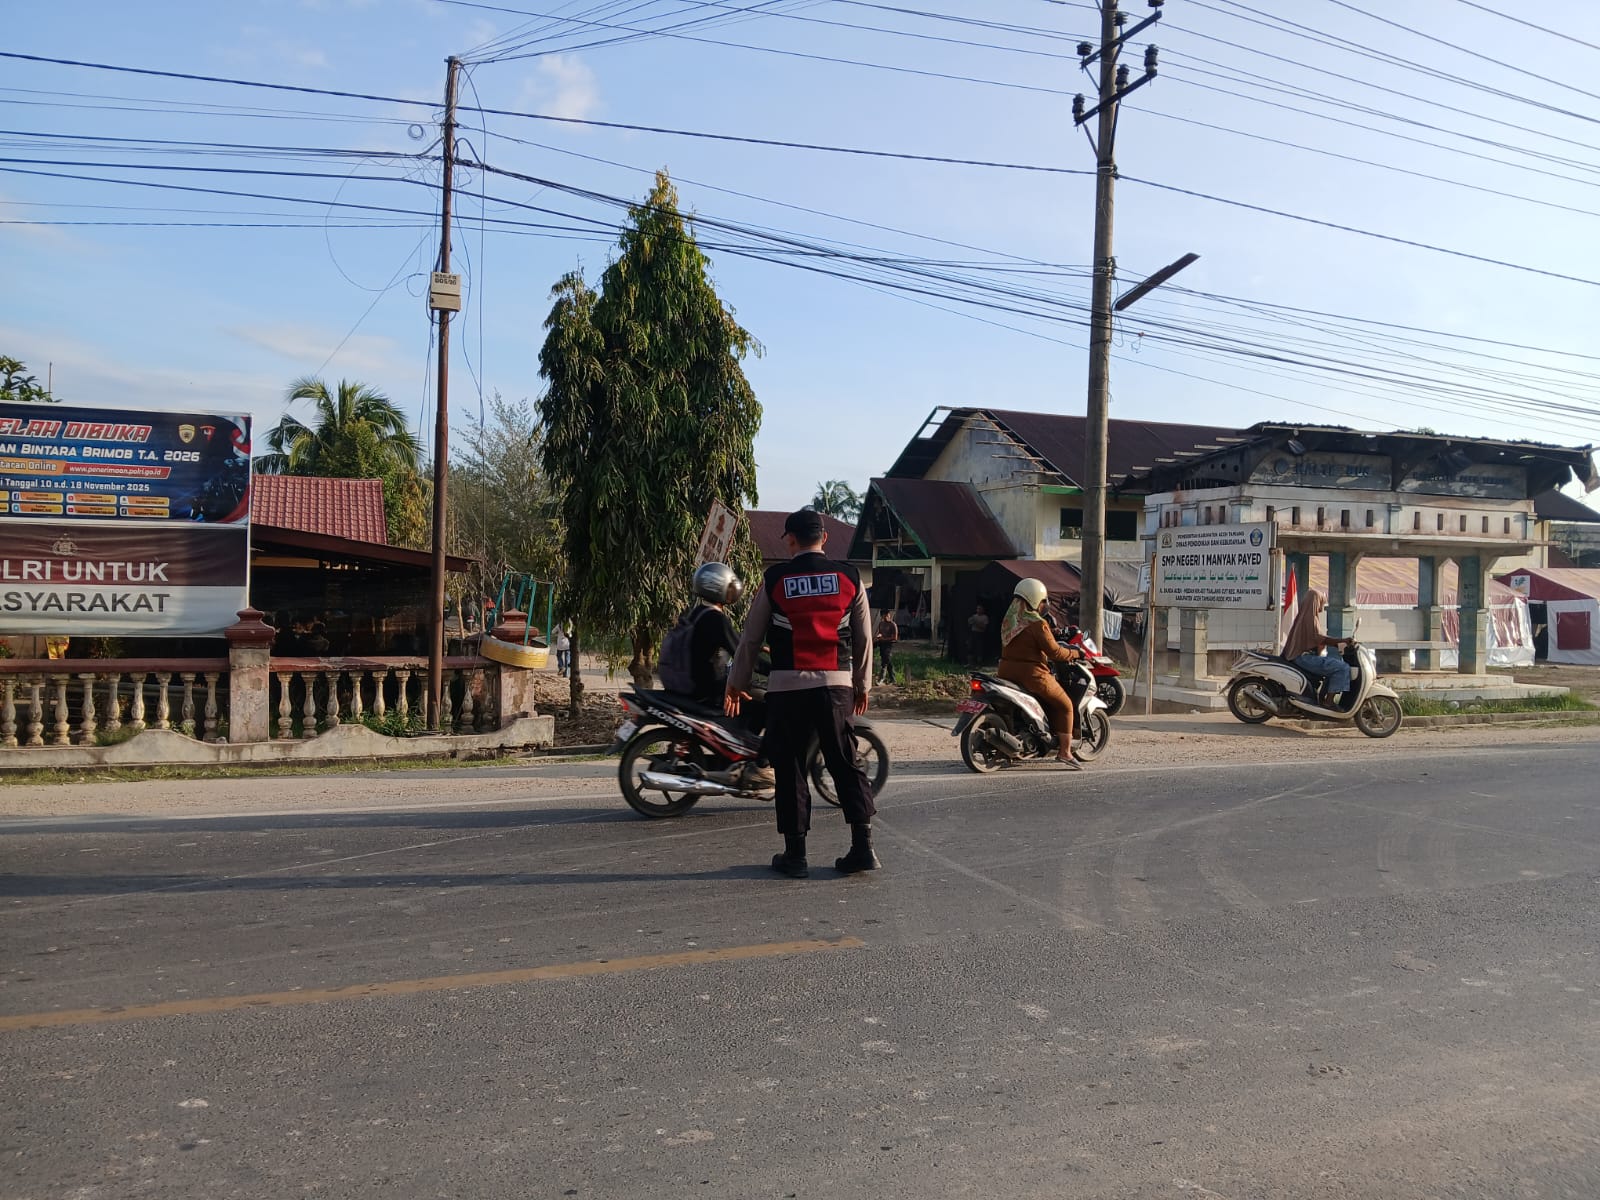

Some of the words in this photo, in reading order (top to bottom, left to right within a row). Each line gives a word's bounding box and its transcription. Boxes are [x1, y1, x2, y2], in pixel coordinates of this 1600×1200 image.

[62, 421, 152, 443] DIBUKA
[21, 443, 77, 457] BINTARA
[82, 446, 133, 459] BRIMOB
[138, 449, 159, 460] T.A.
[164, 450, 200, 462] 2026
[28, 460, 57, 471] Online
[69, 465, 162, 476] www.penerimaan.polri.go.id
[5, 478, 38, 489] Tanggal
[40, 480, 52, 488] 10
[54, 480, 68, 489] s.d.
[70, 481, 82, 489] 18
[84, 481, 126, 491] November
[127, 483, 150, 492] 2025
[1161, 555, 1175, 567] SMP
[1176, 554, 1200, 567] NEGERI
[1201, 554, 1205, 566] 1
[1206, 553, 1237, 566] MANYAK
[1237, 553, 1262, 566] PAYED
[0, 560, 51, 581] LRI
[62, 561, 169, 582] UNTUK
[786, 576, 837, 596] POLISI
[0, 591, 170, 612] SYARAKAT
[646, 706, 694, 734] HONDA
